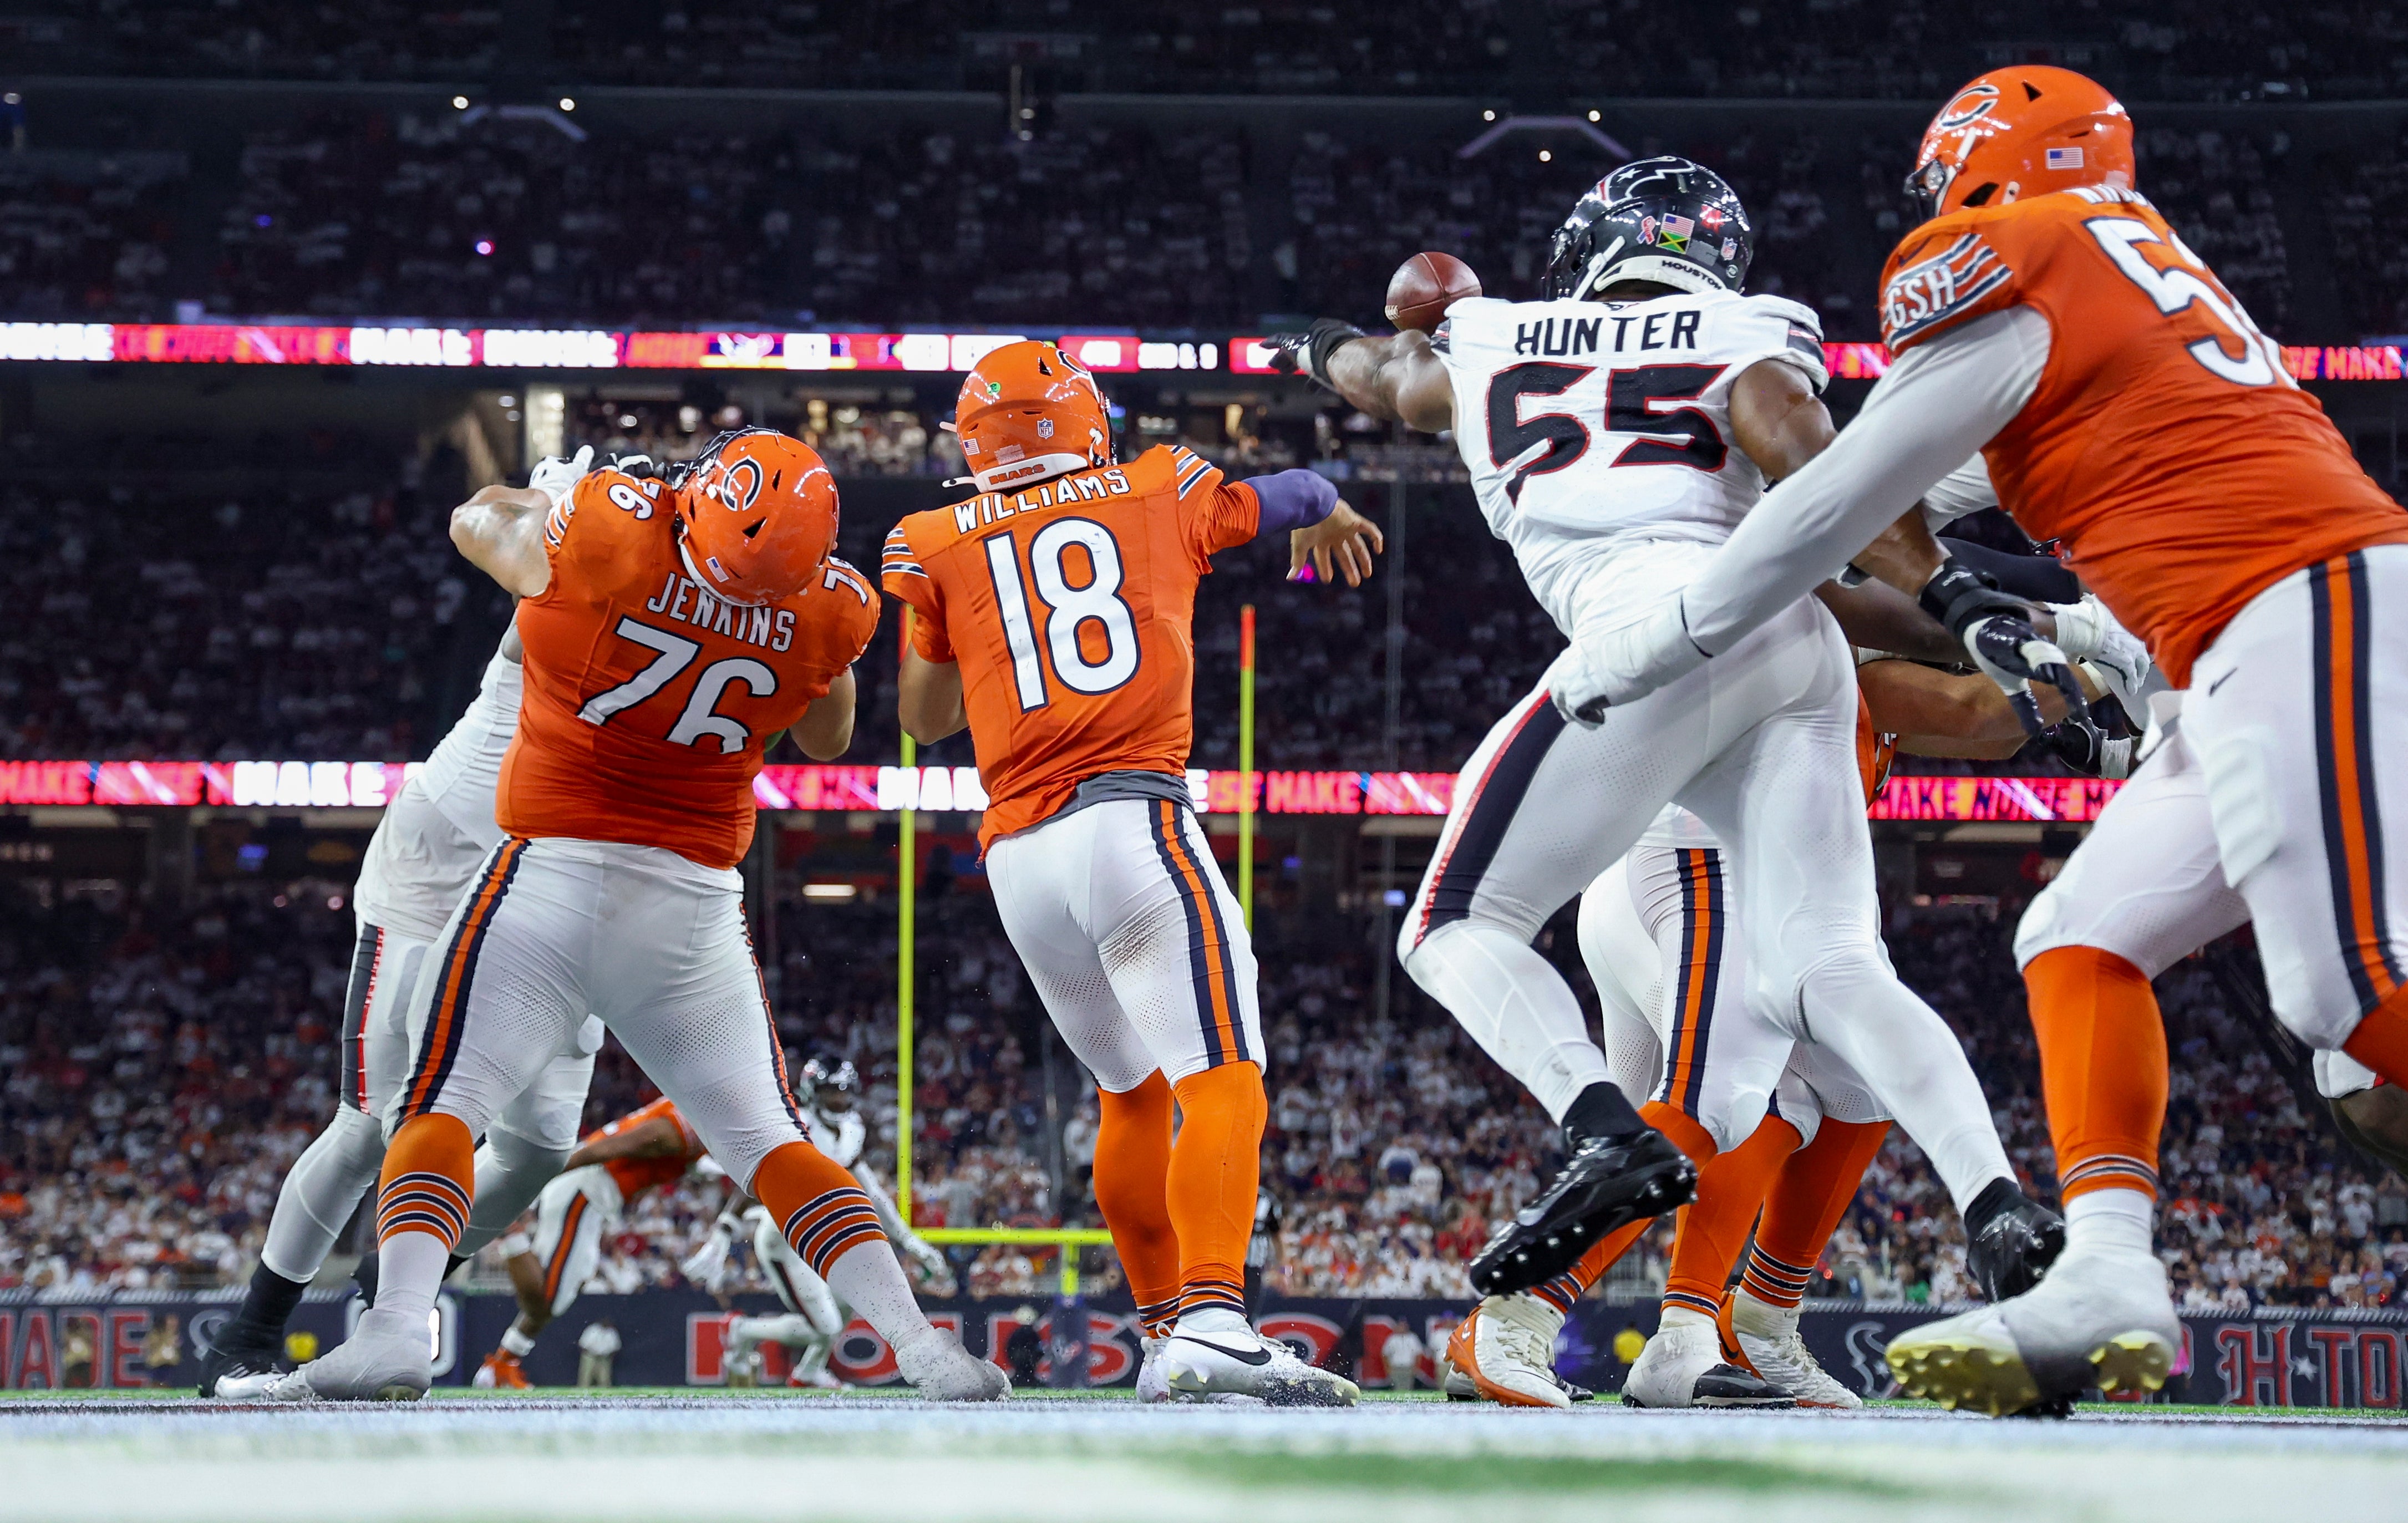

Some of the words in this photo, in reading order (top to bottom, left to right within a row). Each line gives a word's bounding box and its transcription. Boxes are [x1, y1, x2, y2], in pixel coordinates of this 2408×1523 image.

[1662, 260, 1722, 290] HOUSTON
[1887, 262, 1956, 329] GSH
[2082, 215, 2302, 391] 5
[1514, 309, 1701, 356] HUNTER
[2325, 346, 2401, 380] MAKE
[1484, 362, 1732, 508] 55
[953, 469, 1131, 535] WILLIAMS
[988, 463, 1046, 485] BEARS
[647, 571, 796, 653] JENKINS
[983, 516, 1140, 714] 18
[576, 616, 779, 755] 76
[1266, 771, 1360, 814] MAKE
[2306, 1324, 2408, 1408] TO
